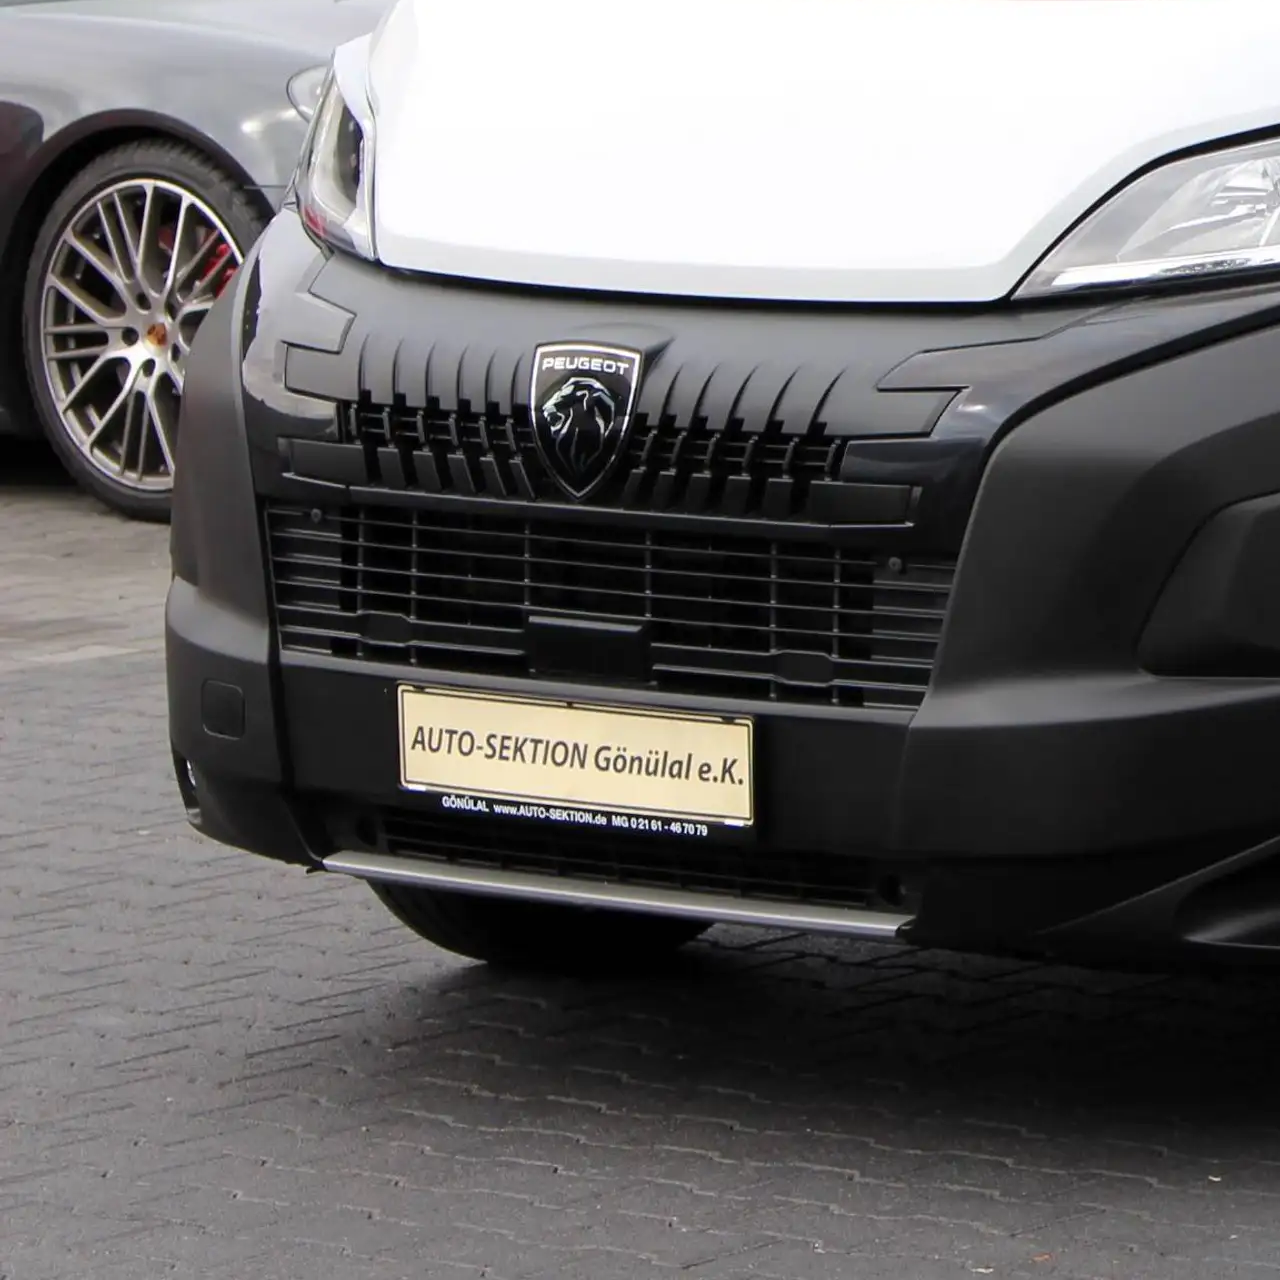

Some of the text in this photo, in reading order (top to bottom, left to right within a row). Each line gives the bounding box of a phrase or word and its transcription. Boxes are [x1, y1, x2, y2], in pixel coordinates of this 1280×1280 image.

[541, 356, 630, 375] PEUGEOT
[411, 725, 744, 786] AUTO-SEKTION Gönülal e.K.
[441, 795, 490, 813] GÖNÜLAL
[493, 803, 607, 826] www.AUTO-SEKTION.de
[611, 814, 629, 828] MG
